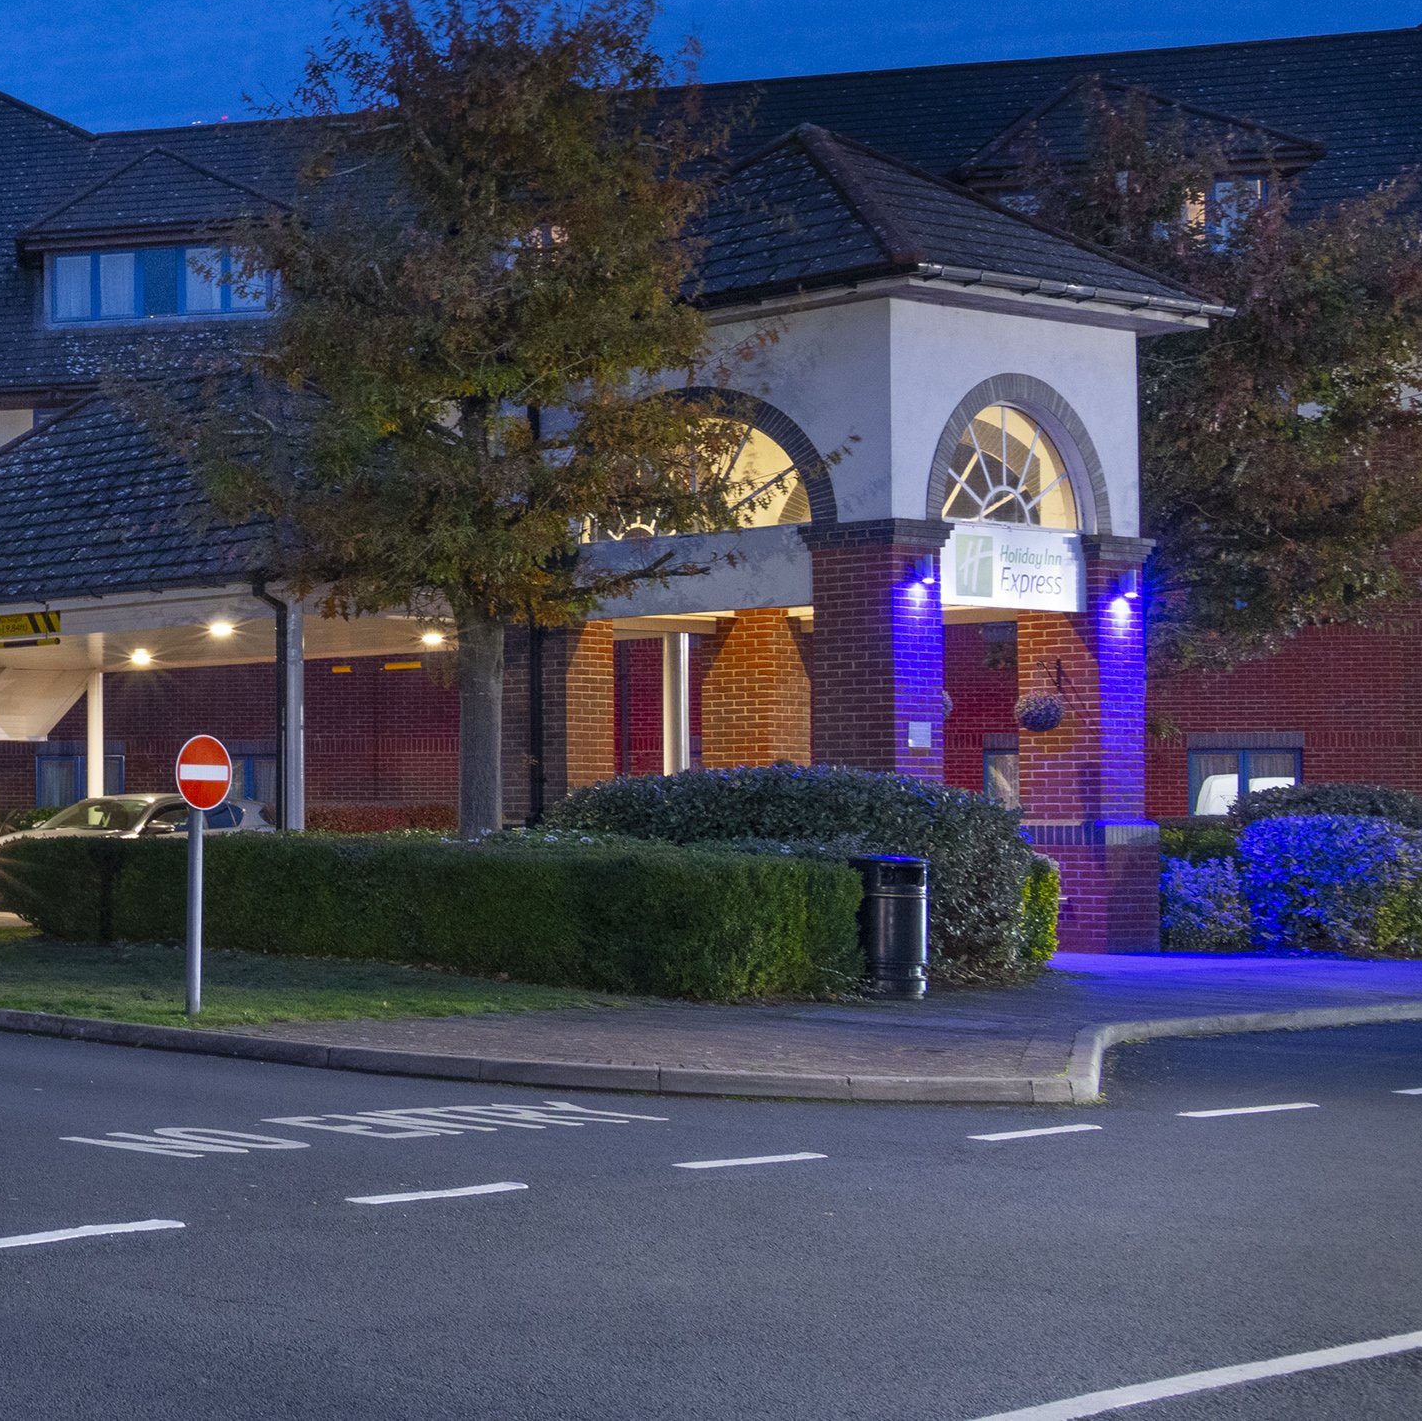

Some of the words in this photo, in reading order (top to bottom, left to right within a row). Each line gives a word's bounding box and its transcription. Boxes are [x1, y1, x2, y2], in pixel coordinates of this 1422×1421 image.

[1000, 545, 1044, 569] Holiday
[1044, 548, 1063, 566] Inn
[1000, 567, 1063, 598] Express
[58, 1127, 311, 1158] NO
[259, 1100, 670, 1139] ENTRY
